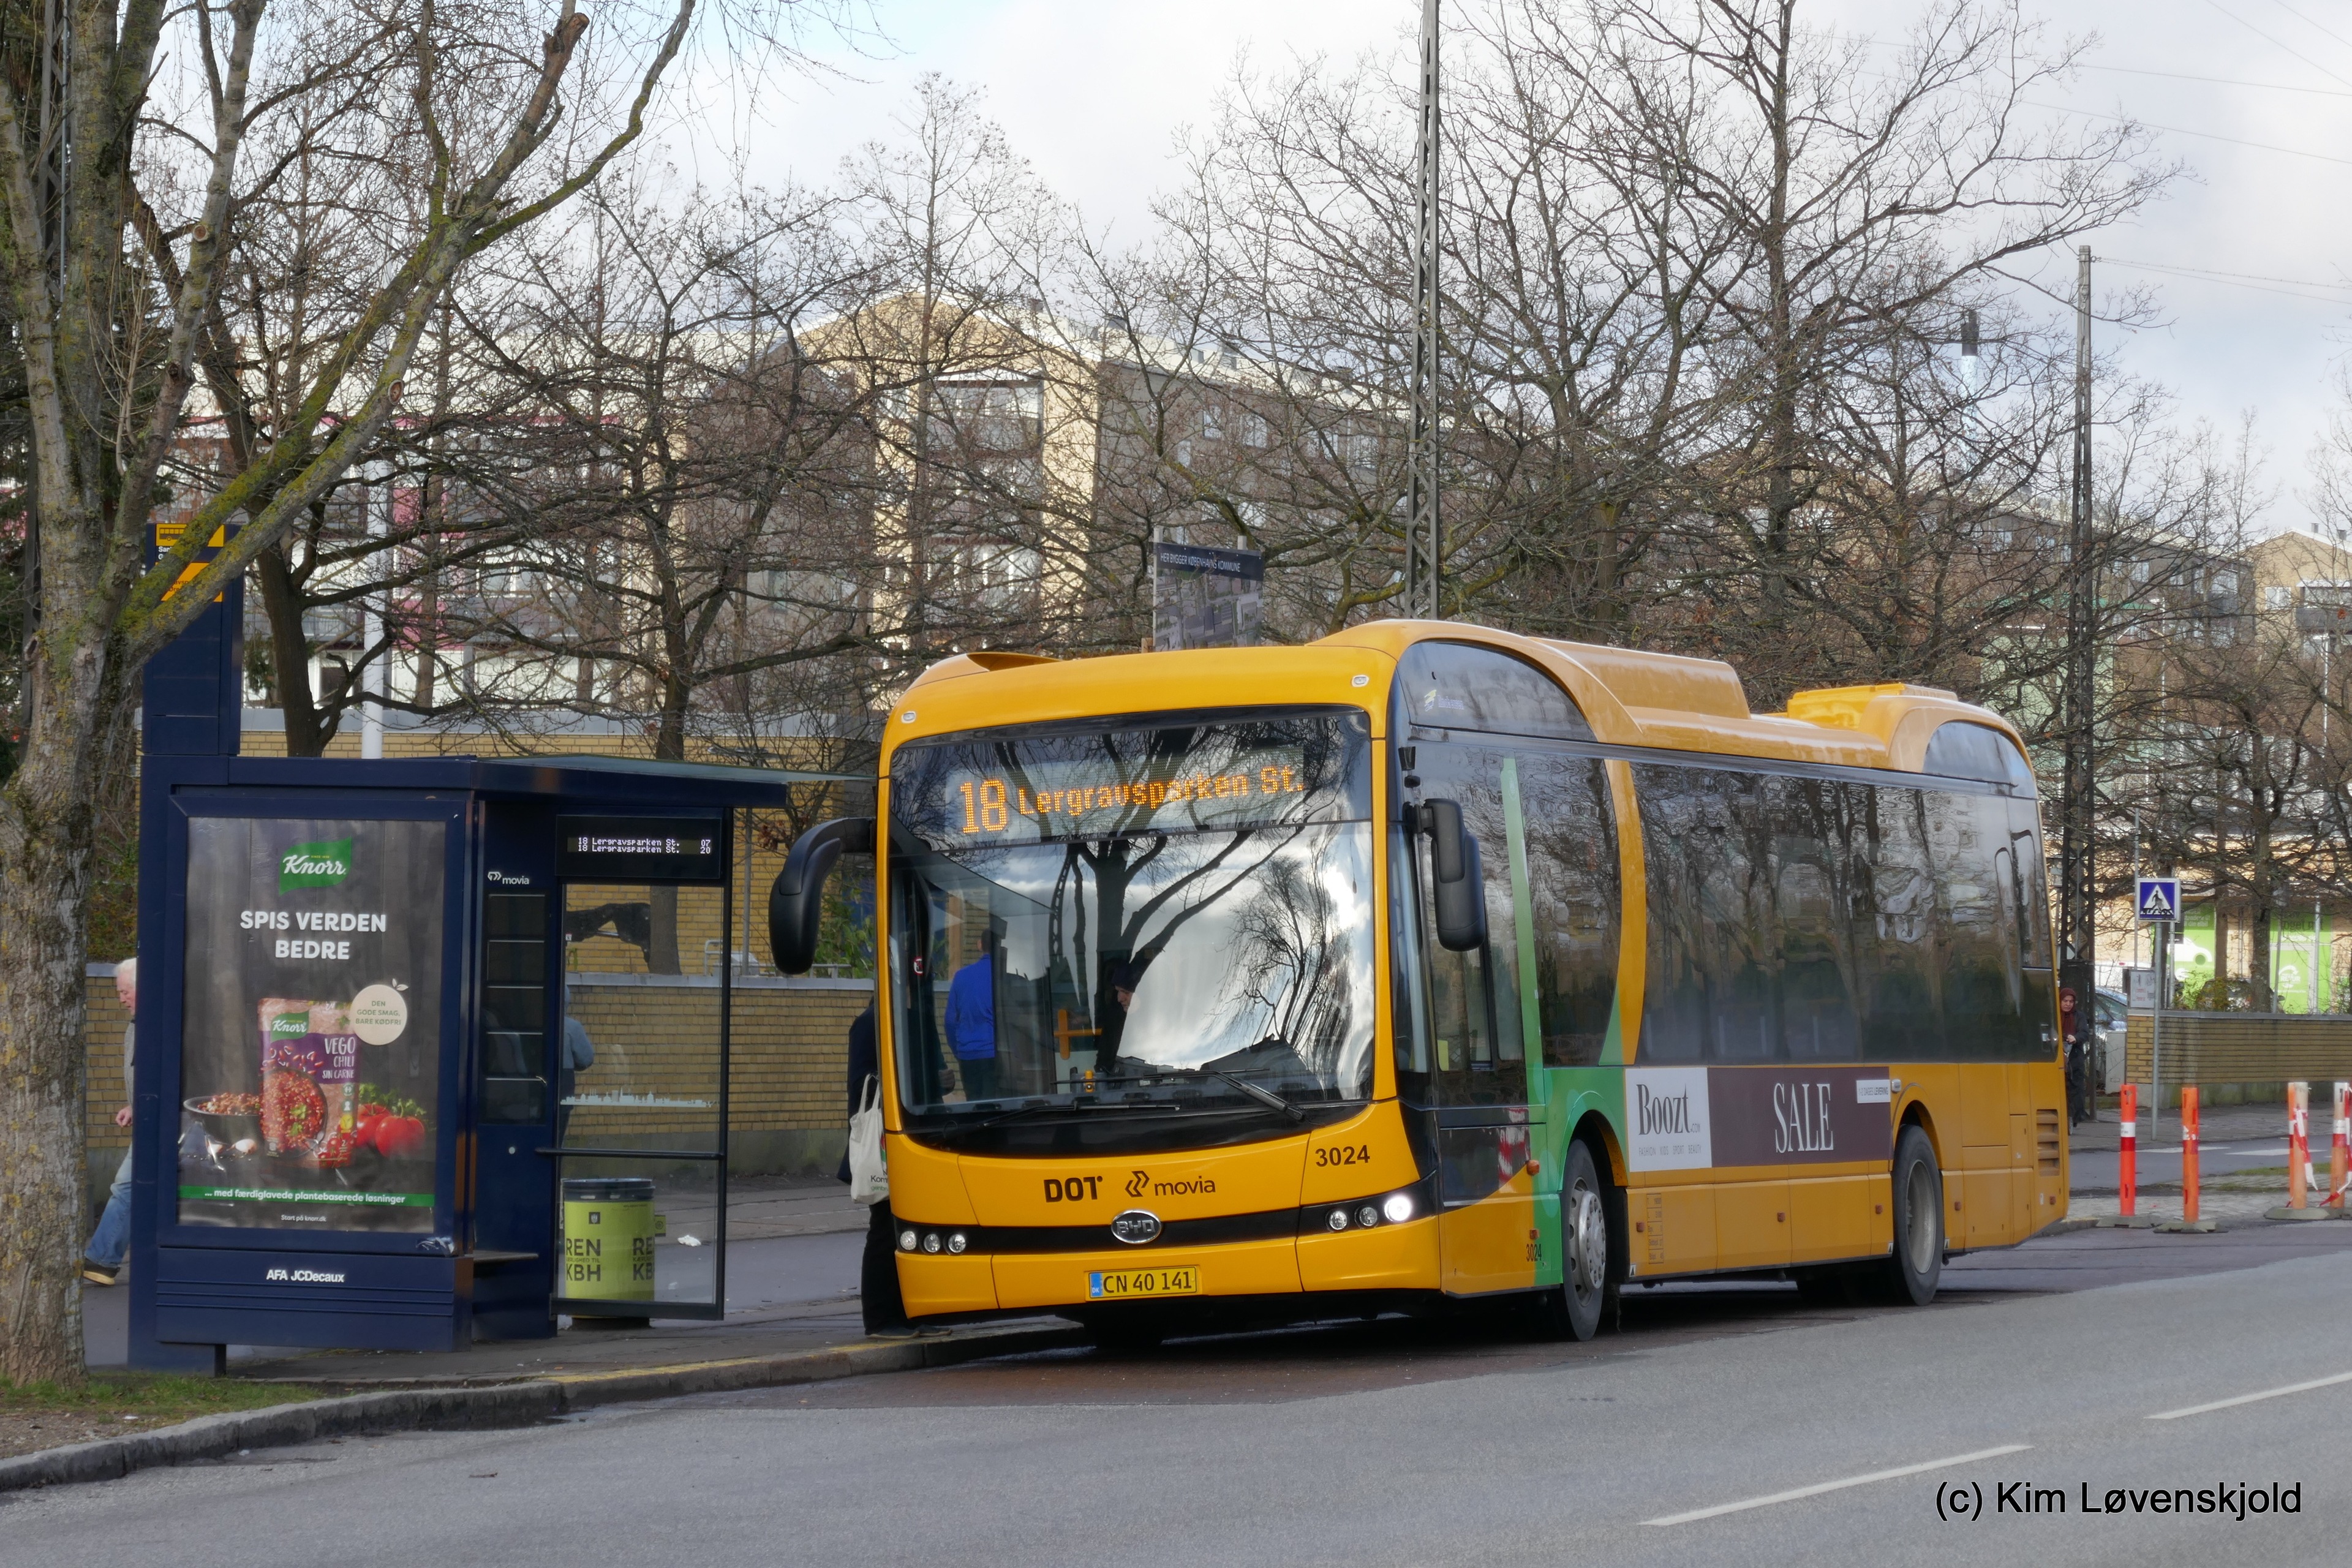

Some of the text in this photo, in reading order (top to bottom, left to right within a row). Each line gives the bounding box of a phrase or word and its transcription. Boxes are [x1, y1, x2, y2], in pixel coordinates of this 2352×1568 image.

[1161, 552, 1169, 562] HER
[1170, 554, 1188, 564] BYGGER
[1218, 560, 1240, 572] KOMMUNE
[960, 766, 1303, 833] 18 Lergravsparken St.
[592, 837, 662, 846] Lergravsparken
[592, 845, 662, 853] Lergravsparken
[282, 854, 344, 875] Knorr
[502, 875, 530, 884] movia
[240, 910, 386, 932] SPIS VERDEN
[275, 940, 350, 960] BEDRE
[272, 1019, 306, 1033] Knorr
[324, 1037, 356, 1054] VEGO
[333, 1056, 355, 1068] CHILI
[322, 1069, 355, 1079] SIN CARNE
[1636, 1083, 1690, 1136] Boozt
[1774, 1083, 1834, 1153] SALE
[1315, 1144, 1371, 1167] 3024
[1044, 1175, 1103, 1203] DOT
[1154, 1175, 1216, 1197] movia
[214, 1189, 233, 1197] med
[235, 1189, 293, 1200] færdiglavede
[295, 1192, 363, 1202] plantebaserede
[365, 1194, 405, 1205] løsninger
[1116, 1219, 1156, 1235] BYD
[566, 1238, 601, 1257] REN
[1526, 1243, 1542, 1262] 3024
[266, 1269, 345, 1283] AFA JCDecaux
[566, 1264, 601, 1281] KBH
[1104, 1272, 1192, 1294] CN 40 141
